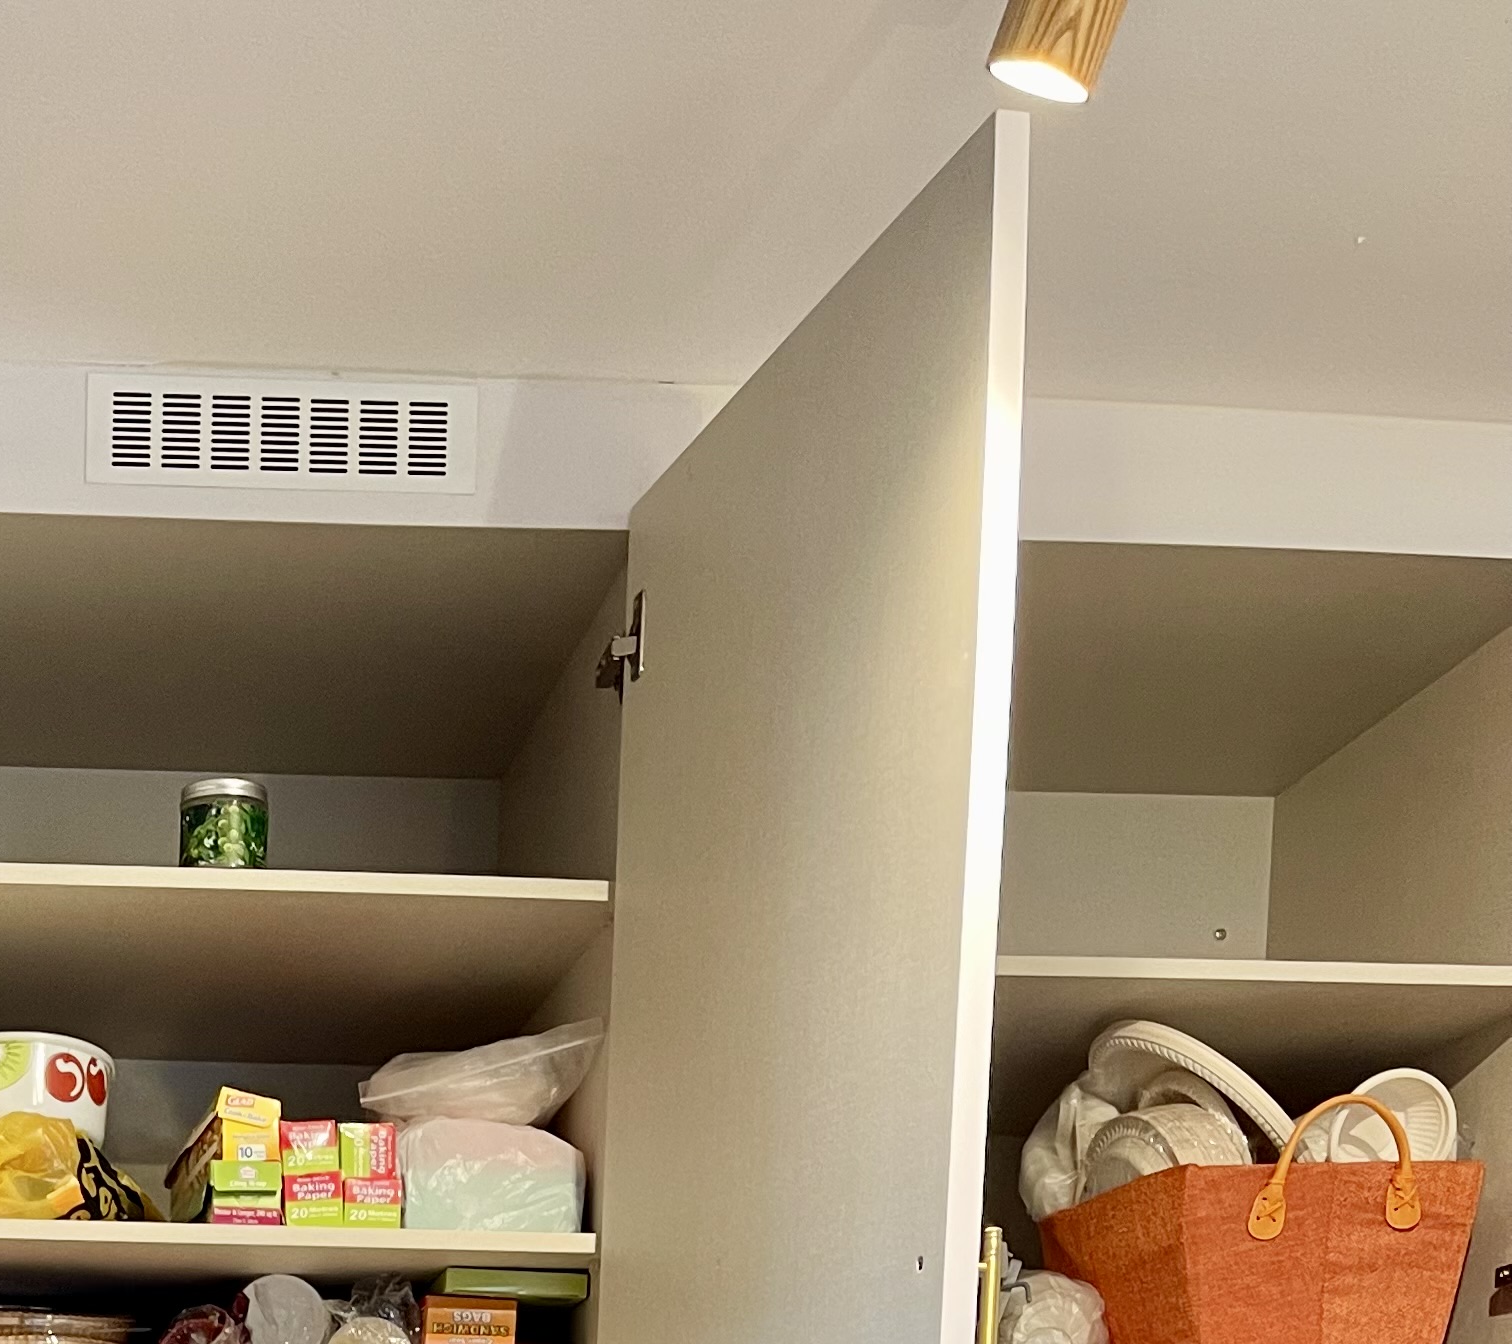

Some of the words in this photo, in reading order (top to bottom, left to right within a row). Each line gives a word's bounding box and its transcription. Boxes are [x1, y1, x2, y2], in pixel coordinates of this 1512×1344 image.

[239, 1147, 253, 1158] 10
[369, 1135, 379, 1171] Paper
[377, 1130, 387, 1174] Baking
[288, 1155, 305, 1166] 20
[292, 1182, 336, 1193] Baking
[352, 1186, 395, 1198] Baking
[298, 1190, 333, 1200] Paper
[356, 1195, 392, 1204] Paper
[291, 1207, 308, 1218] 20
[349, 1209, 367, 1220] 20
[453, 1311, 491, 1323] BAGS
[432, 1322, 510, 1336] SANDWICH
